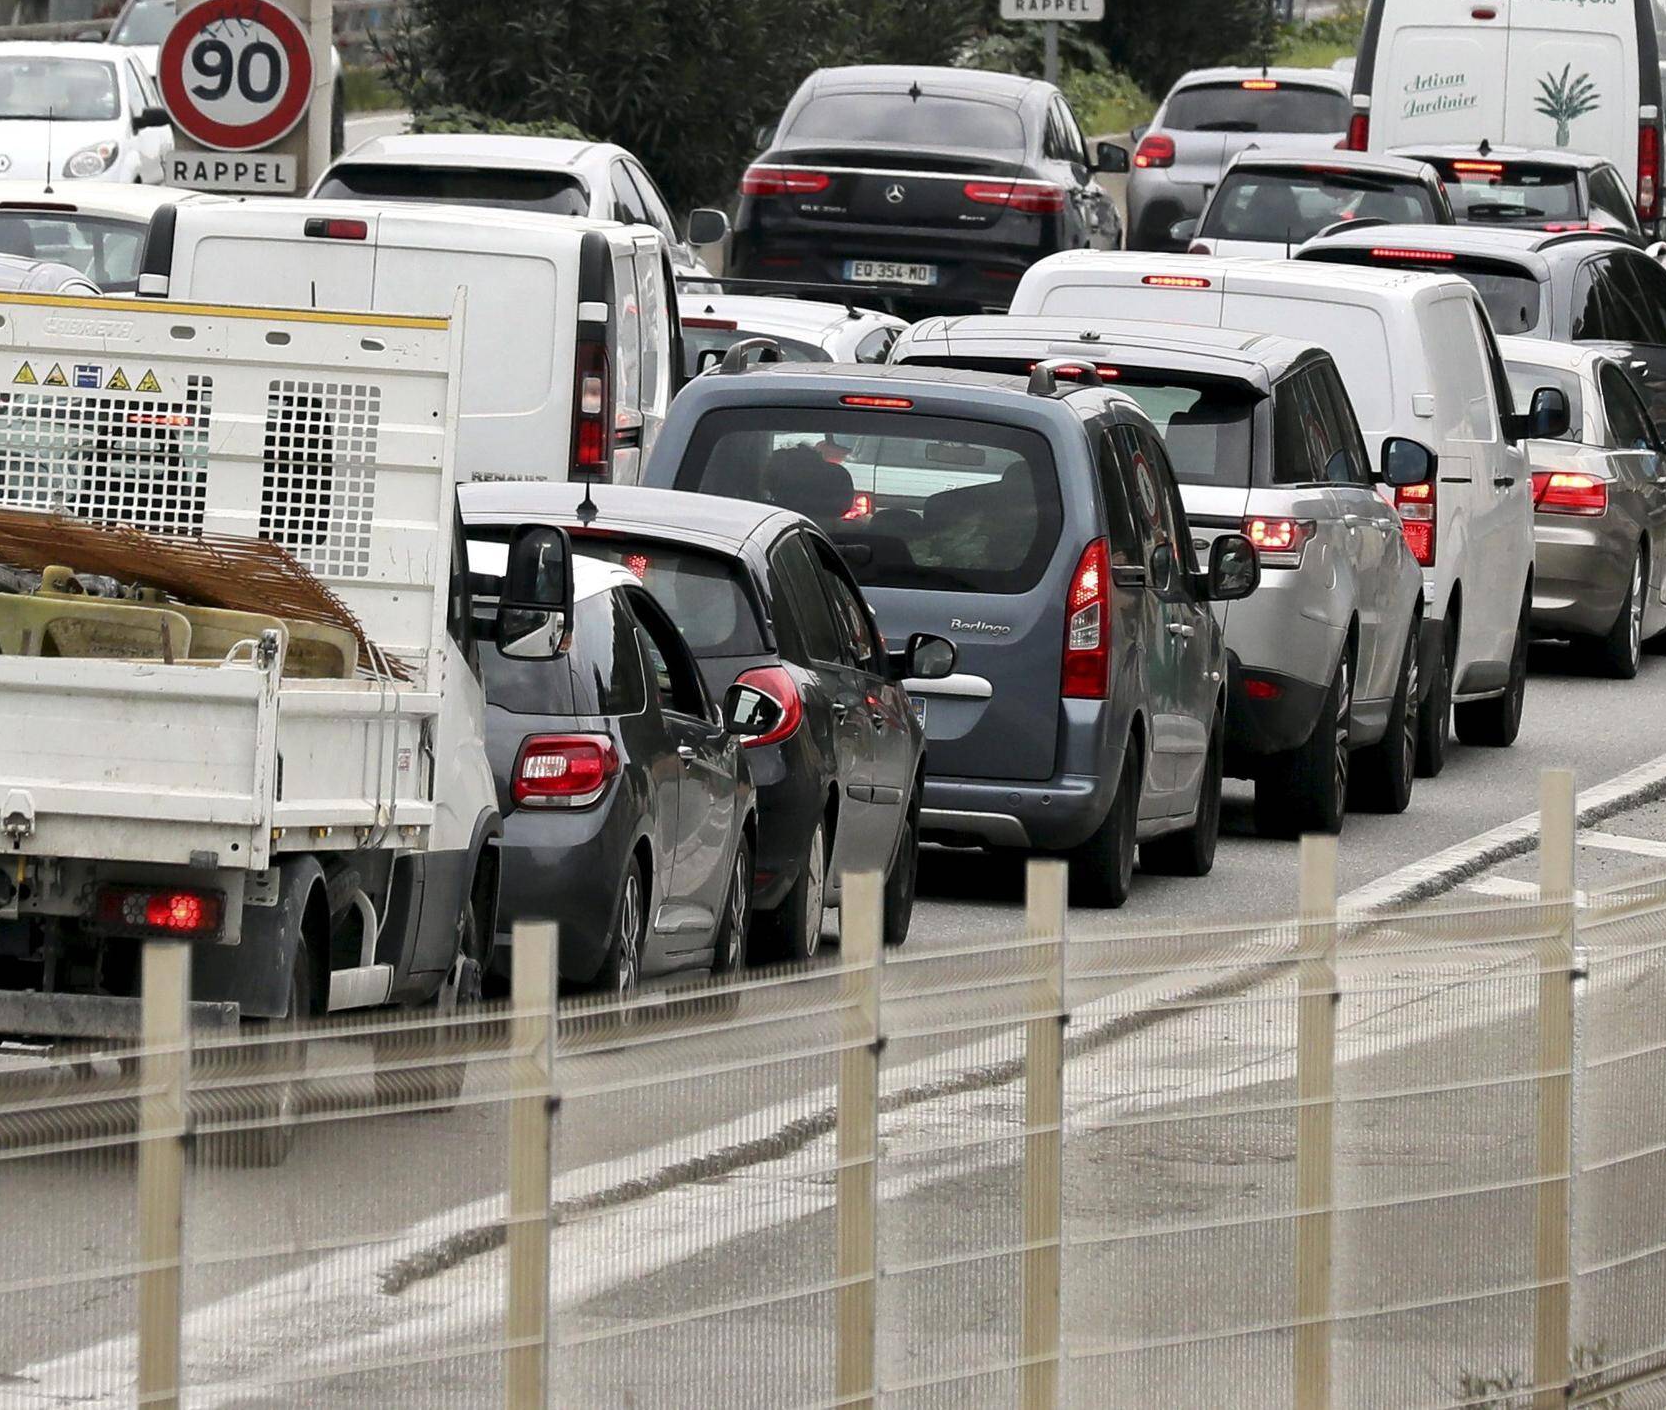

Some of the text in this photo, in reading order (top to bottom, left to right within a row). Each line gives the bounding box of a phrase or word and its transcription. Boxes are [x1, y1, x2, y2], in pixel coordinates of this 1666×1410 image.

[191, 40, 282, 103] 90
[1404, 72, 1466, 92] Artisan
[1404, 93, 1478, 118] Jardinier
[173, 160, 287, 184] RAPPEL
[951, 618, 1011, 637] Berlingo
